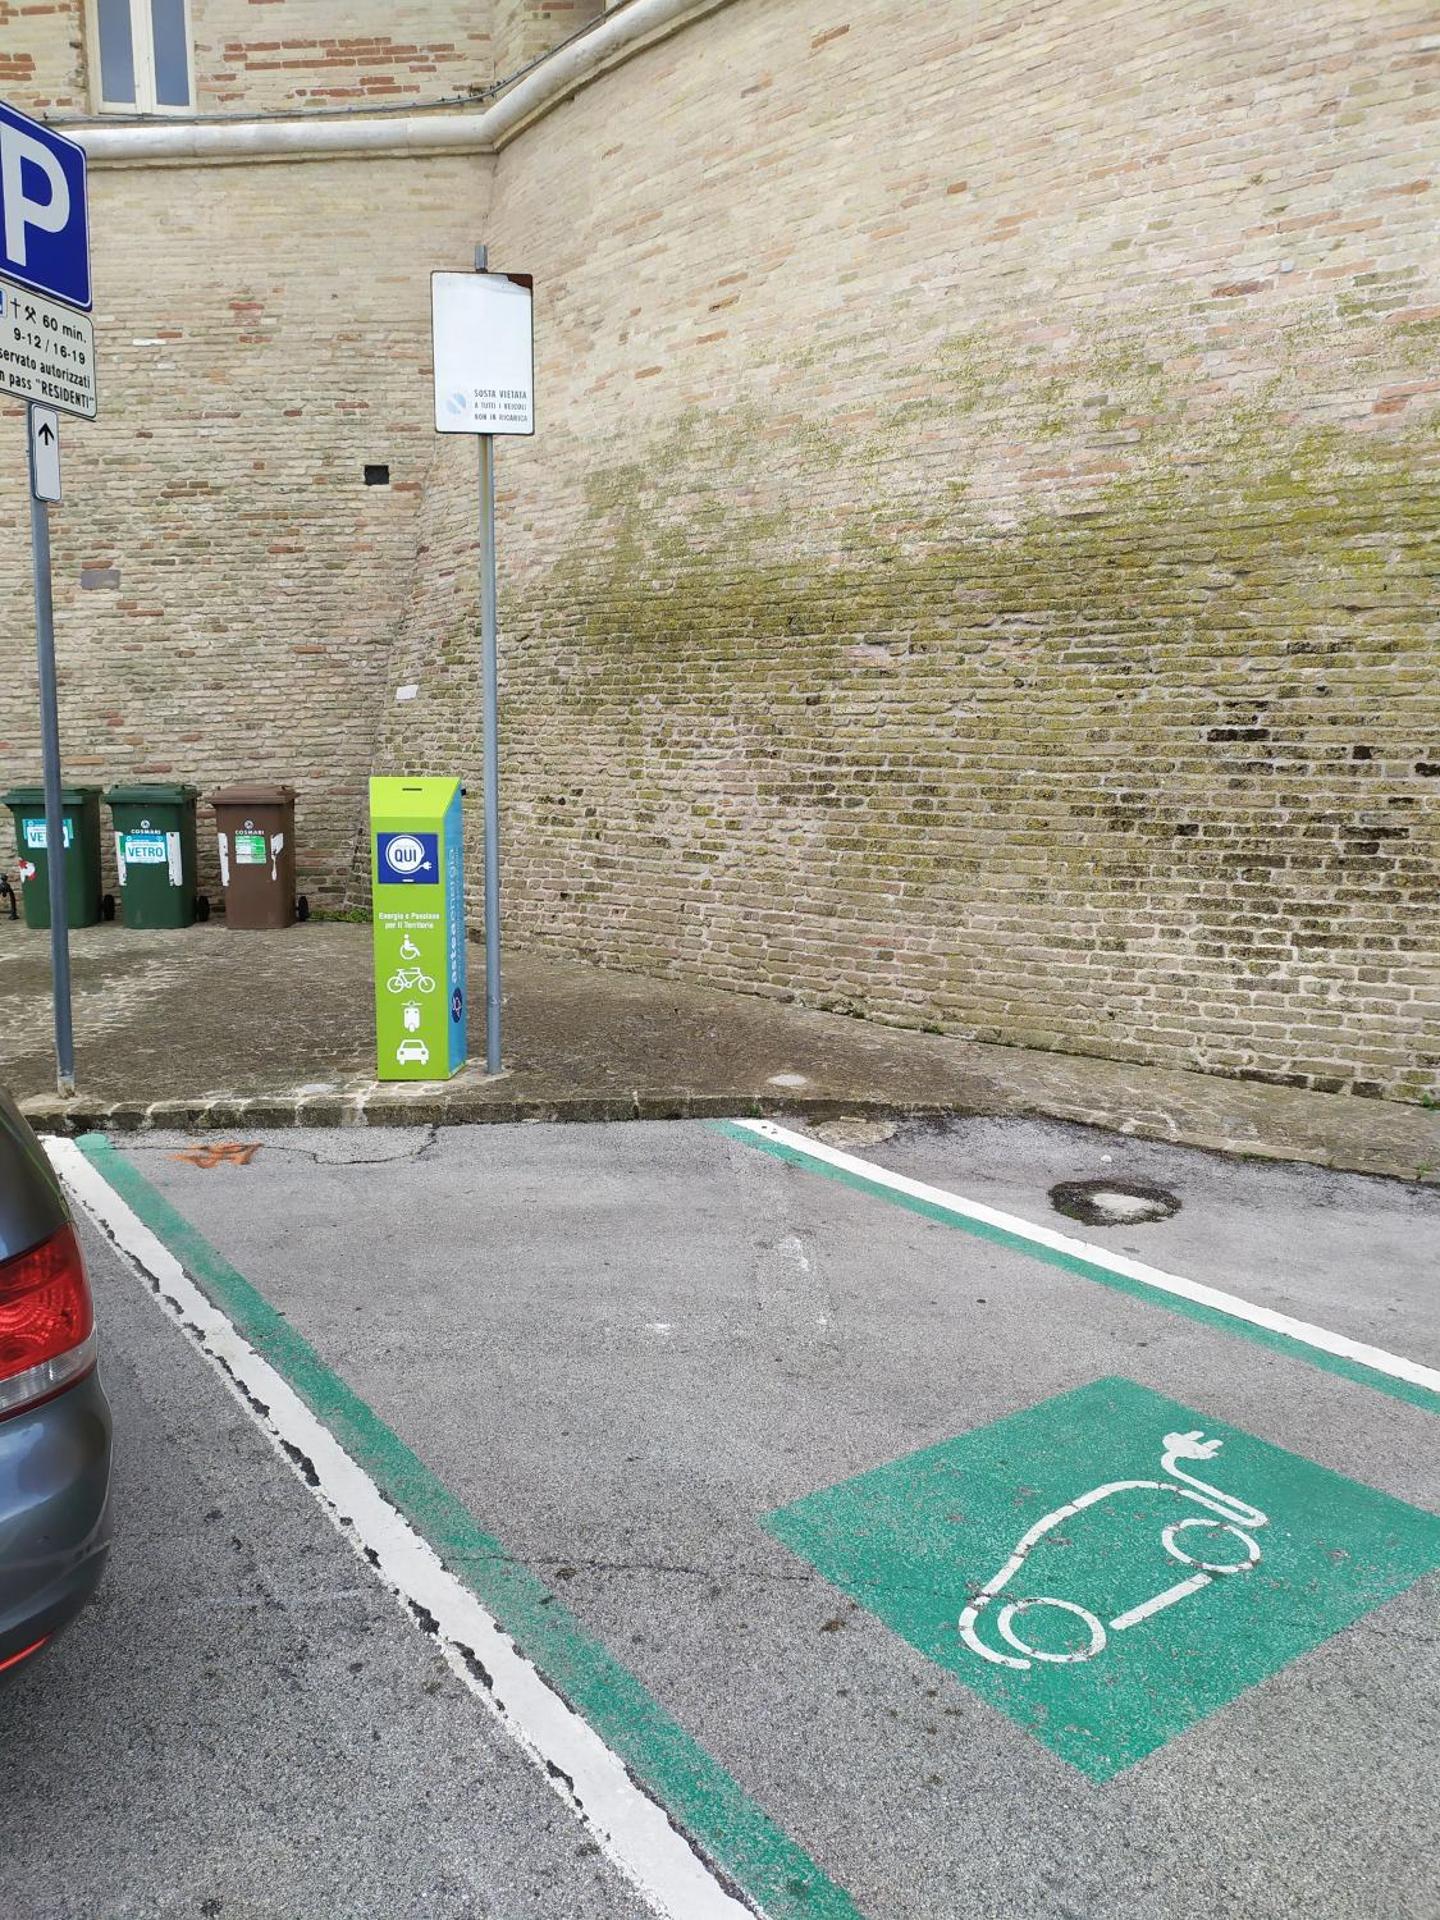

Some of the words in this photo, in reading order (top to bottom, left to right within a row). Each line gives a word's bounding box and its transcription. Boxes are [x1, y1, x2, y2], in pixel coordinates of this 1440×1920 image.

[0, 121, 70, 267] P
[42, 315, 58, 331] 60
[62, 325, 87, 343] min.
[13, 327, 42, 348] 9-12
[54, 342, 85, 365] 16-19
[9, 372, 32, 390] pass
[40, 361, 91, 388] autorizzati
[474, 389, 496, 398] SOSTA
[498, 390, 527, 399] VIETATA
[127, 847, 163, 857] VETRO
[395, 849, 416, 863] QUI
